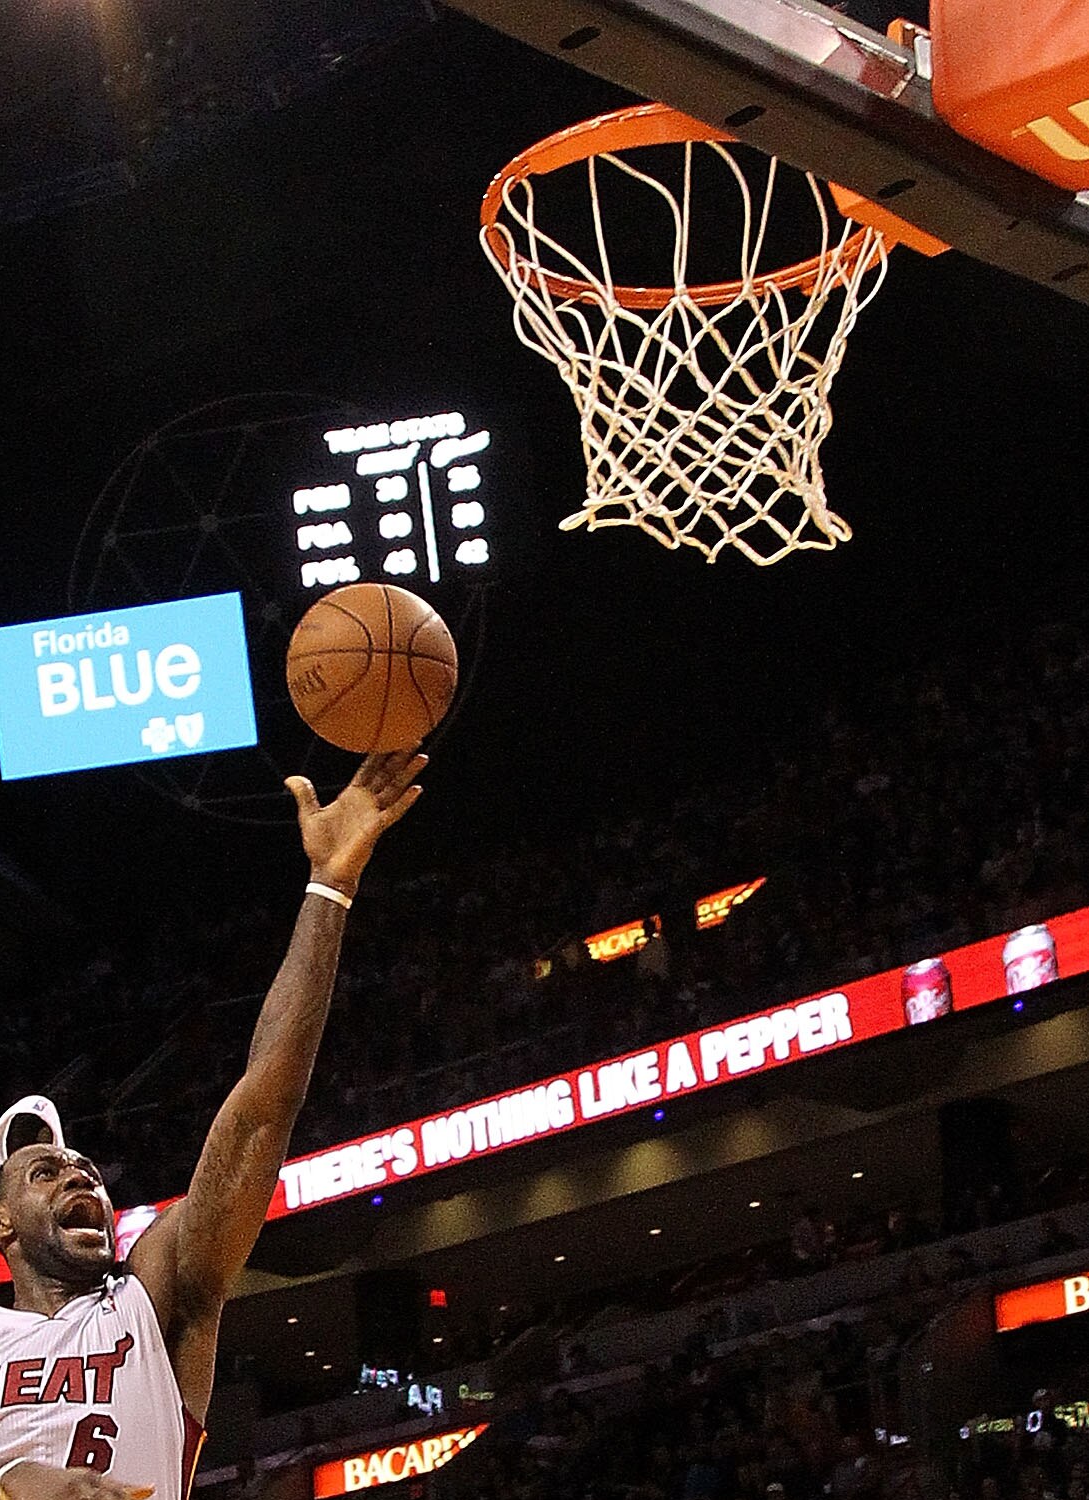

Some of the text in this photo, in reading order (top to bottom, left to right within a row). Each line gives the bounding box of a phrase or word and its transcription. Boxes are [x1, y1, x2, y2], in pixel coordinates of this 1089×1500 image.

[32, 621, 130, 657] Florida
[278, 1127, 418, 1210] THERE'S
[420, 1079, 575, 1168] NOTHING
[578, 1050, 662, 1119] LIKE
[665, 1041, 698, 1094] A
[699, 992, 853, 1083] PEPPER
[66, 1412, 119, 1477] 6
